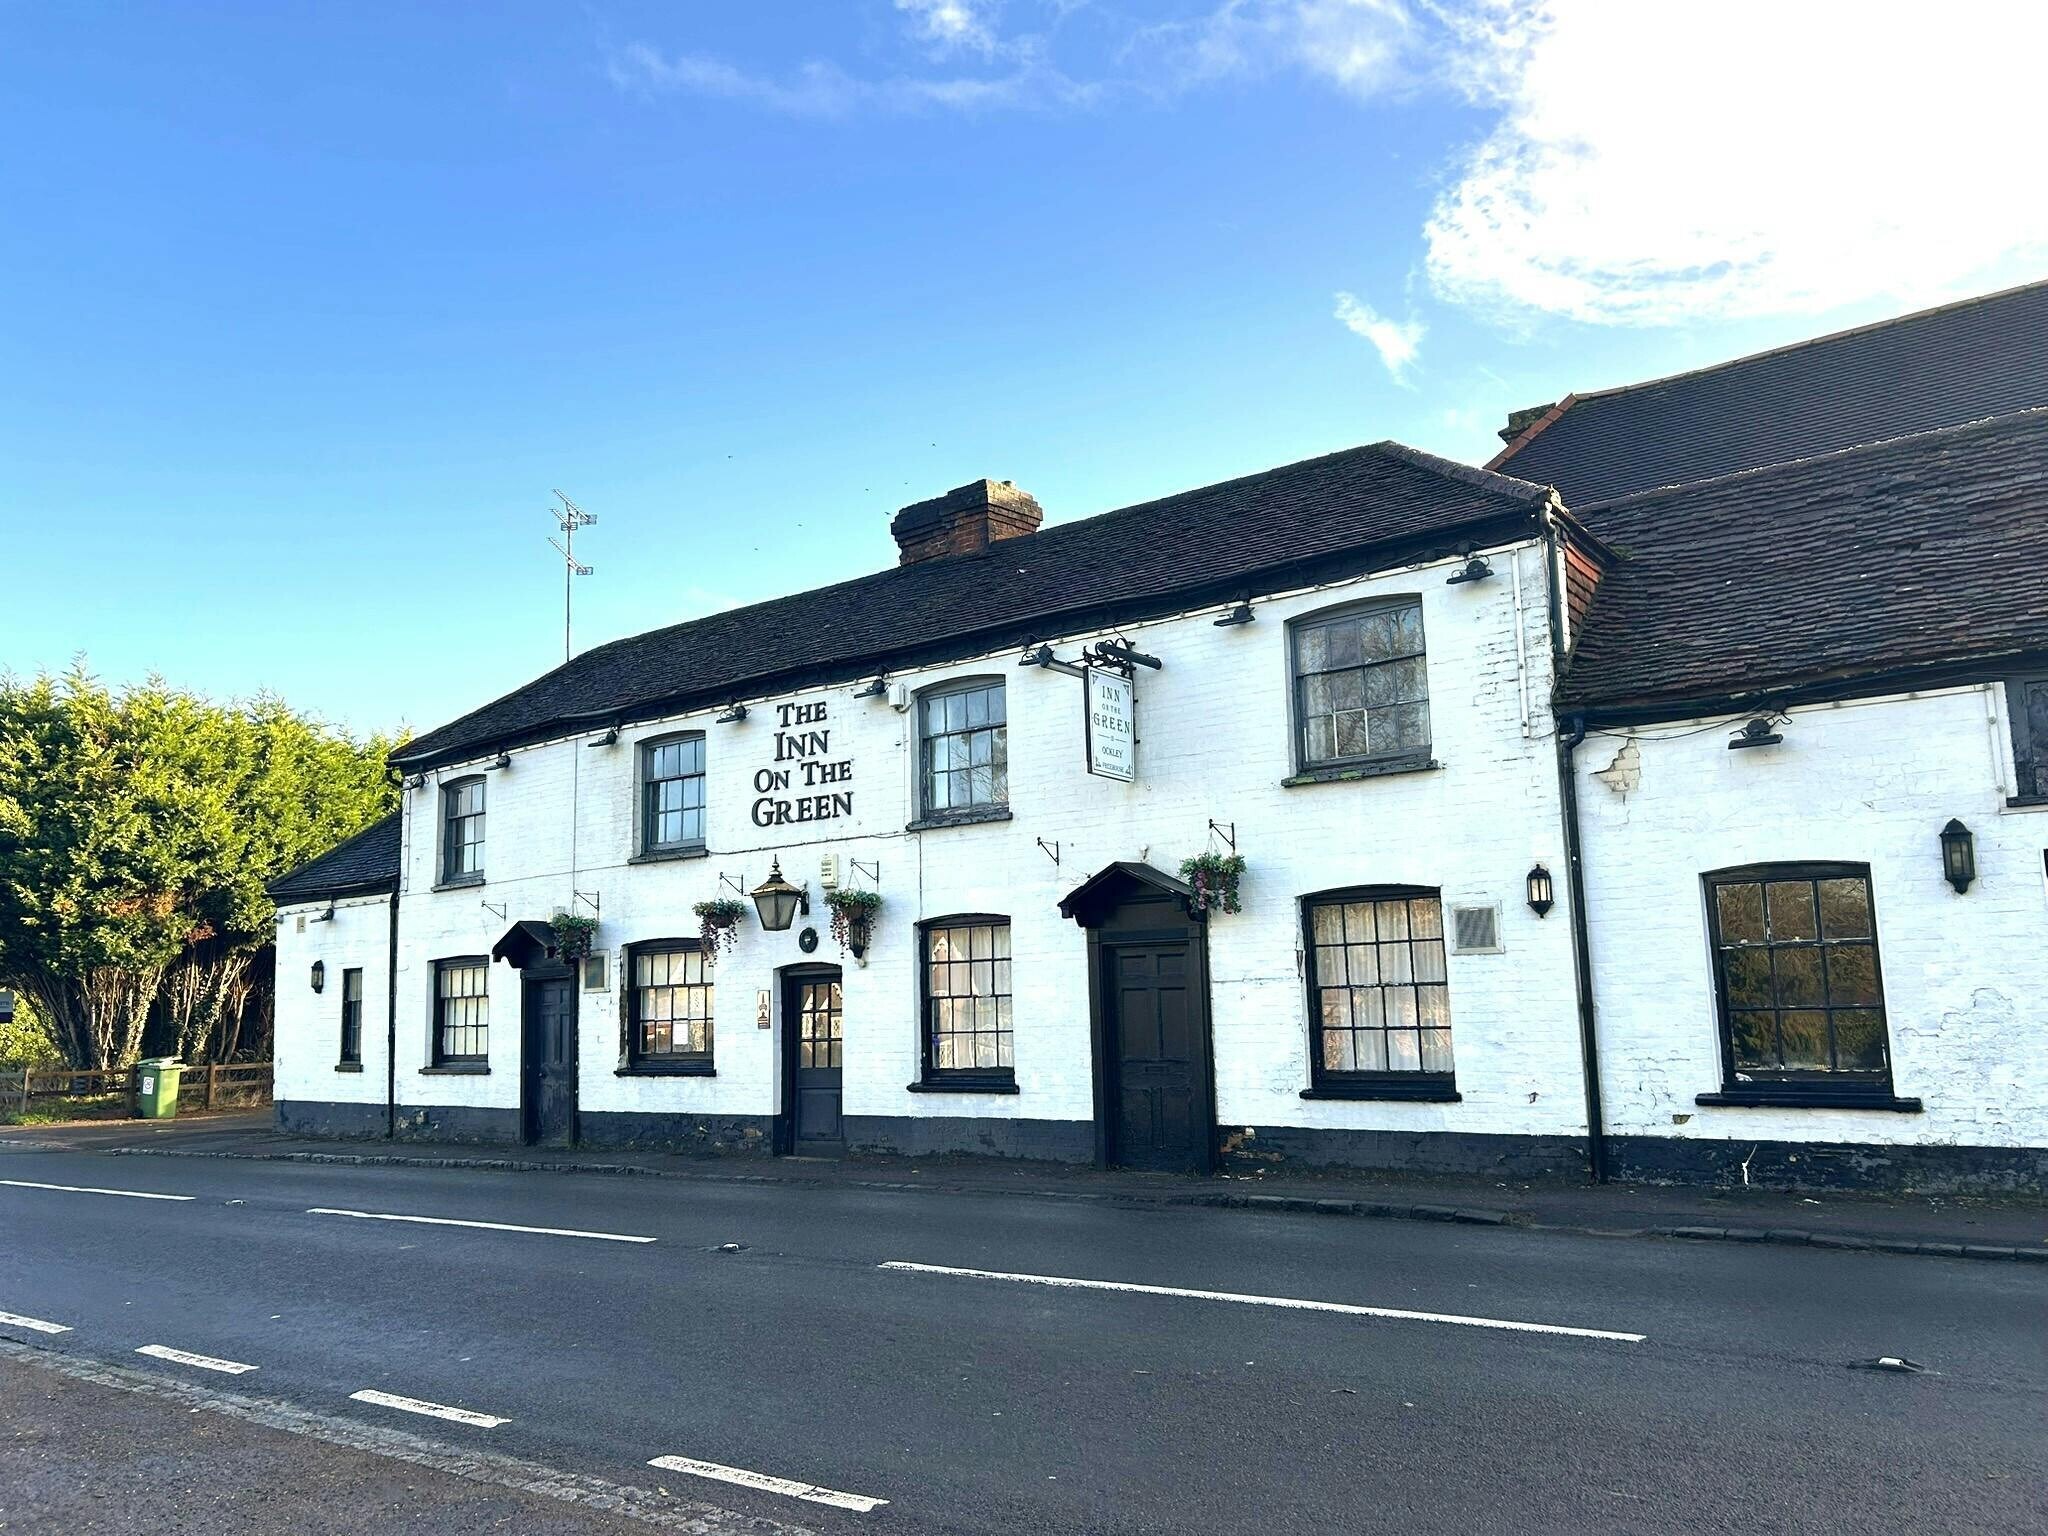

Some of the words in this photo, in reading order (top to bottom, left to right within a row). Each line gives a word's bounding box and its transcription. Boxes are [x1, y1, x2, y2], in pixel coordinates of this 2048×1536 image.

[1102, 685, 1120, 702] INN
[776, 701, 828, 728] THE
[1110, 705, 1121, 715] THE
[1093, 712, 1130, 734] GREEN
[773, 729, 831, 762] INN
[1101, 745, 1123, 759] OCKLEY
[753, 768, 791, 794] ON
[800, 760, 853, 786] THE
[751, 791, 854, 828] GREEN
